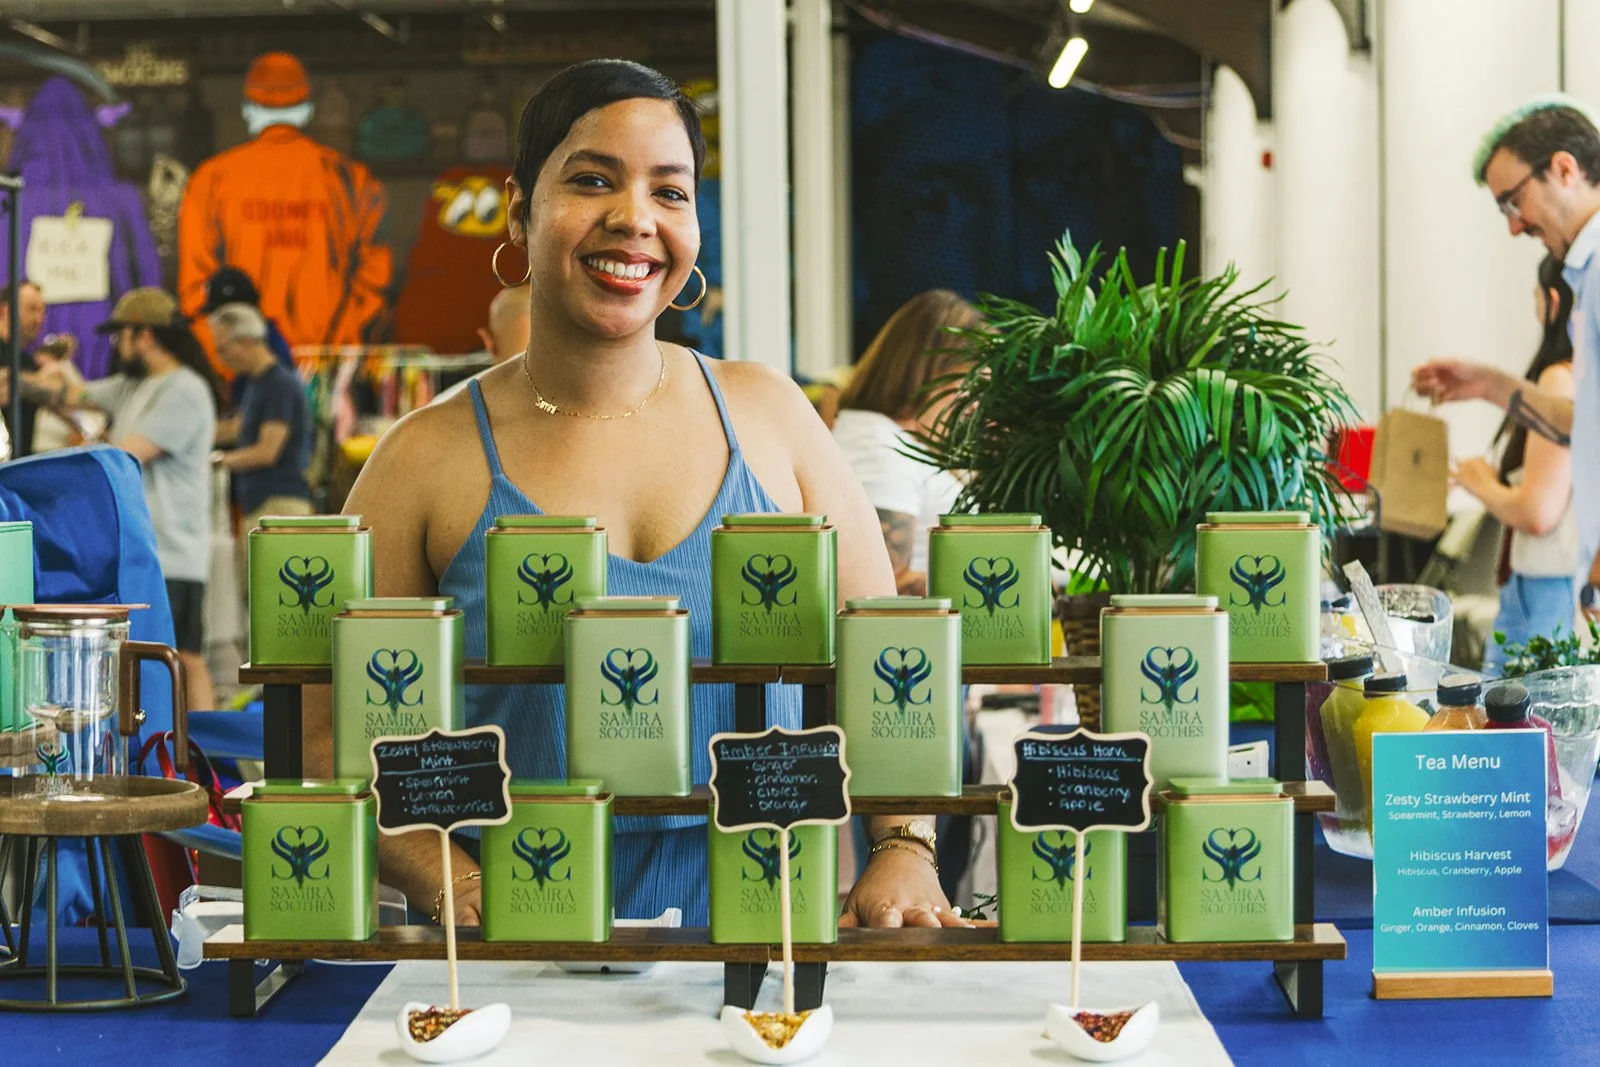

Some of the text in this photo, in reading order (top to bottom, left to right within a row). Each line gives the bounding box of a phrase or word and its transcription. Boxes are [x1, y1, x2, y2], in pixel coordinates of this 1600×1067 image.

[278, 613, 331, 626] SAMIR
[516, 611, 563, 624] SAMIR
[740, 612, 801, 625] SAMIRA
[963, 615, 1023, 627] SAMIRA
[1231, 612, 1289, 625] SAMIRA
[739, 626, 802, 637] SOOTHES
[962, 627, 1024, 639] SOOTHES
[365, 712, 427, 726] SAMIRA
[600, 712, 662, 726] SAMIRA
[872, 711, 935, 725] SAMIRA
[1139, 710, 1202, 725] SAMIRA
[599, 727, 664, 739] SOOTHES
[871, 726, 936, 739] SOOTHES
[720, 743, 772, 757] Amber
[1023, 742, 1086, 757] Hibiscus
[1415, 754, 1501, 770] Tea Menu
[1056, 764, 1119, 781] Hibiscus
[1384, 791, 1531, 808] Zesty Strawberry Mint
[1388, 809, 1531, 821] Spearmint, Strawberry, Lemon
[1409, 850, 1512, 861] Hibiscus Harvest
[1397, 865, 1522, 877] Hibiscus, Cranberry, Apple
[271, 886, 334, 900] SAMIRA
[511, 888, 574, 901] SAMIRA
[741, 888, 805, 901] SAMIA
[1031, 888, 1095, 901] SAMIA
[1200, 889, 1265, 902] SAMIRA
[270, 900, 336, 912] SOOTHES
[510, 902, 577, 914] SOOTHES
[740, 902, 807, 914] SOOTES
[1200, 902, 1267, 914] SOOTHES
[1412, 905, 1505, 917] Amber Infusion
[1380, 921, 1539, 934] Ginger, Orange, Cinnamon, Cloves
